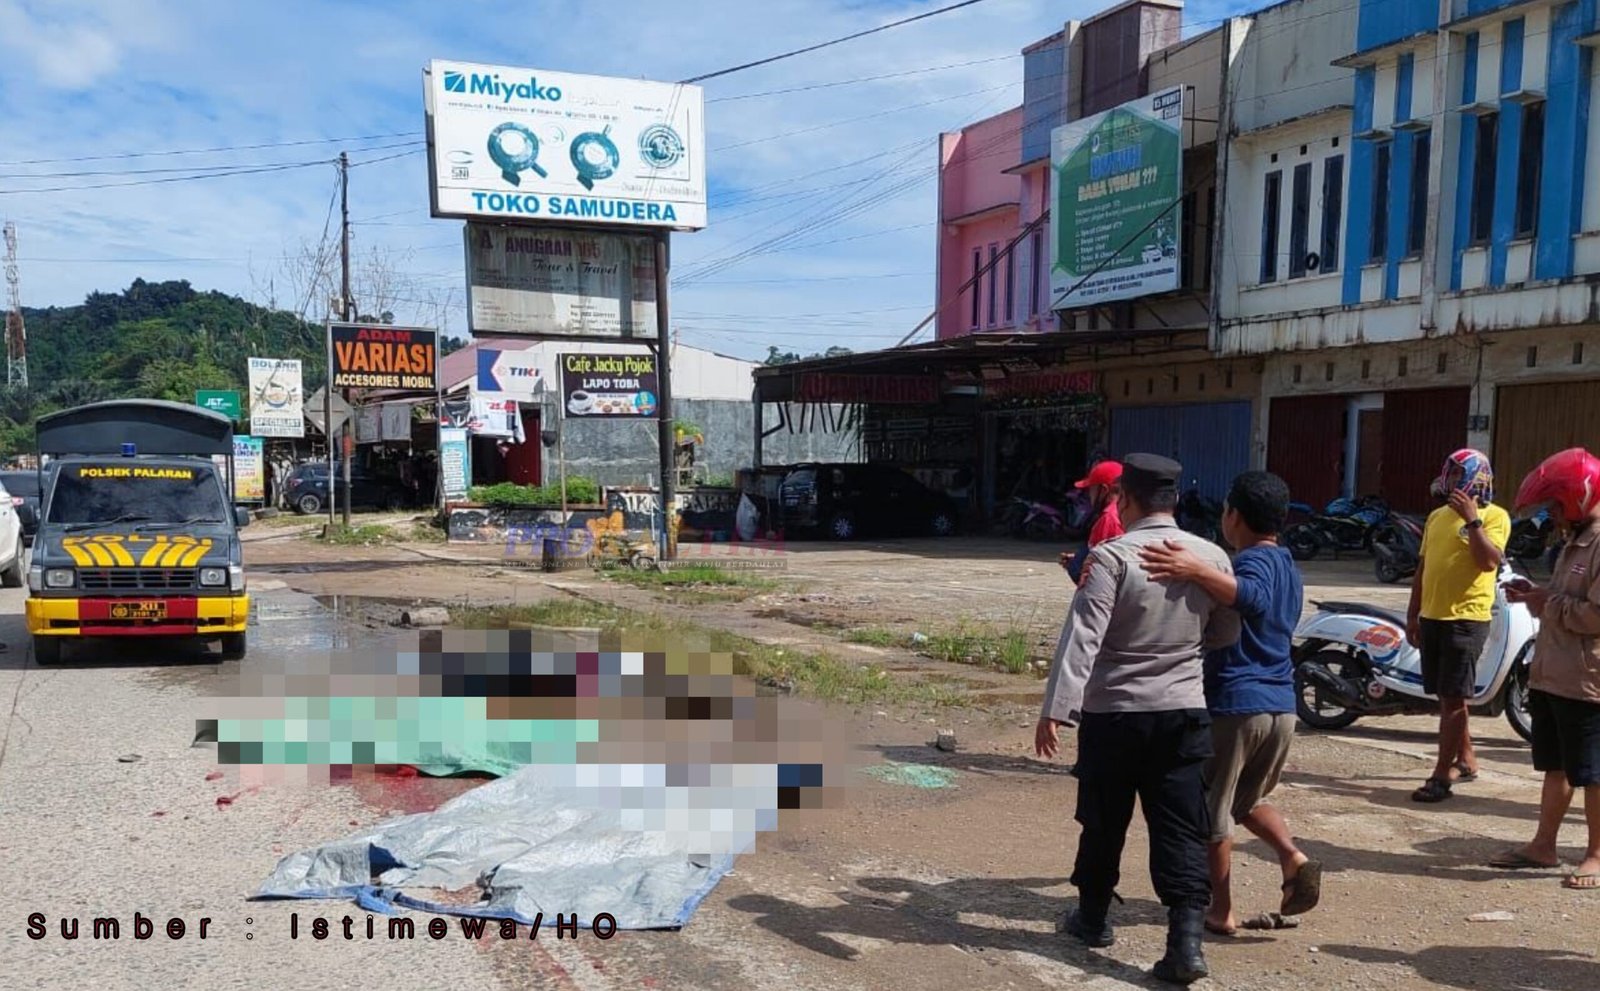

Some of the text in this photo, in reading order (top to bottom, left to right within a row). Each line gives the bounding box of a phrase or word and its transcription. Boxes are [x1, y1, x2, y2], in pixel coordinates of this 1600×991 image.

[470, 74, 562, 103] Miyako
[472, 192, 677, 222] TOKO SAMUDERA
[506, 237, 572, 257] ANUGRAH
[532, 257, 618, 275] Tour & Travel
[357, 329, 411, 342] ADAM
[335, 341, 434, 374] VARIASI
[509, 366, 540, 377] TIKI
[566, 356, 654, 376] Cafe Jacky Pojok
[335, 374, 434, 389] ACCESORIES MOBIL
[583, 379, 641, 389] LAPO TOBA
[80, 468, 192, 479] POLSEK PALARAN
[61, 534, 213, 546] POLISI
